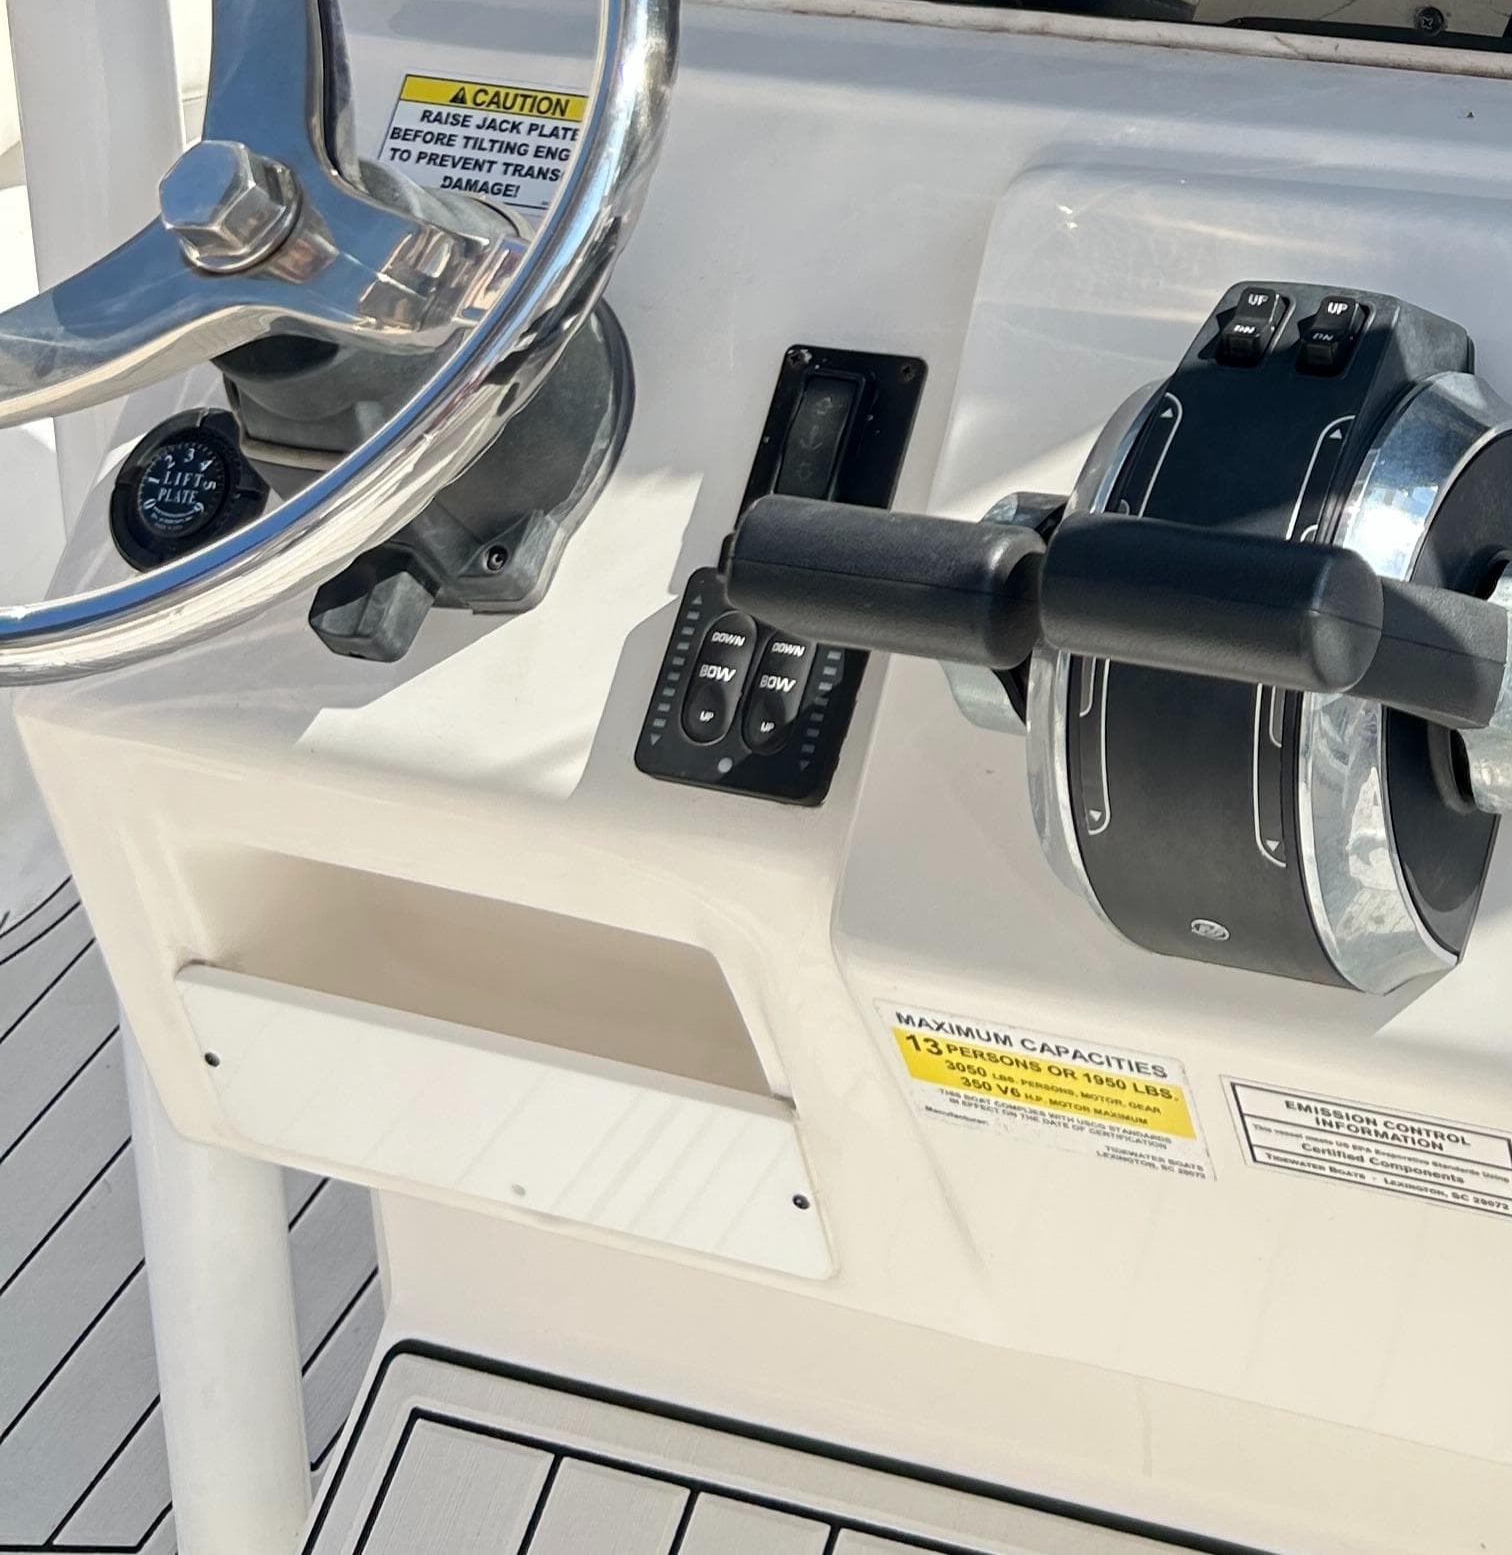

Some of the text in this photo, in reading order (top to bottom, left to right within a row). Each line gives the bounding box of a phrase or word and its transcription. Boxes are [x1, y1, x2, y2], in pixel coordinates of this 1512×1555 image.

[472, 88, 570, 117] CAUTION
[420, 109, 580, 142] RAISE JACK PLATE
[390, 126, 458, 147] BEFORE
[463, 135, 529, 157] TILTING
[390, 148, 564, 182] TO PREVENT TRANS
[441, 176, 520, 198] DAMAGE!
[1247, 294, 1269, 306] UP
[1327, 302, 1348, 314] UP
[163, 471, 204, 487] LIFT
[158, 487, 199, 504] PLATE
[712, 631, 746, 646] DOWN
[772, 642, 805, 657] DOWN
[699, 664, 736, 682] BOW
[759, 675, 796, 692] BOW
[700, 711, 714, 722] UP
[760, 721, 775, 732] UP
[896, 1012, 1168, 1078] MAXIMUM CAPACITIES
[905, 1034, 1180, 1102] 13 PERSONS OR 1950 LBS.
[945, 1060, 987, 1077] 3050
[1128, 1101, 1161, 1114] GEAR
[960, 1076, 992, 1092] 350
[996, 1084, 1021, 1098] V6
[1049, 1098, 1090, 1112] MOTOR
[1094, 1107, 1148, 1125] MAXIMUM
[1285, 1100, 1471, 1146] EMISSION CONTROL
[1315, 1117, 1444, 1151] INFORMATION
[1302, 1143, 1464, 1184] Certified Components
